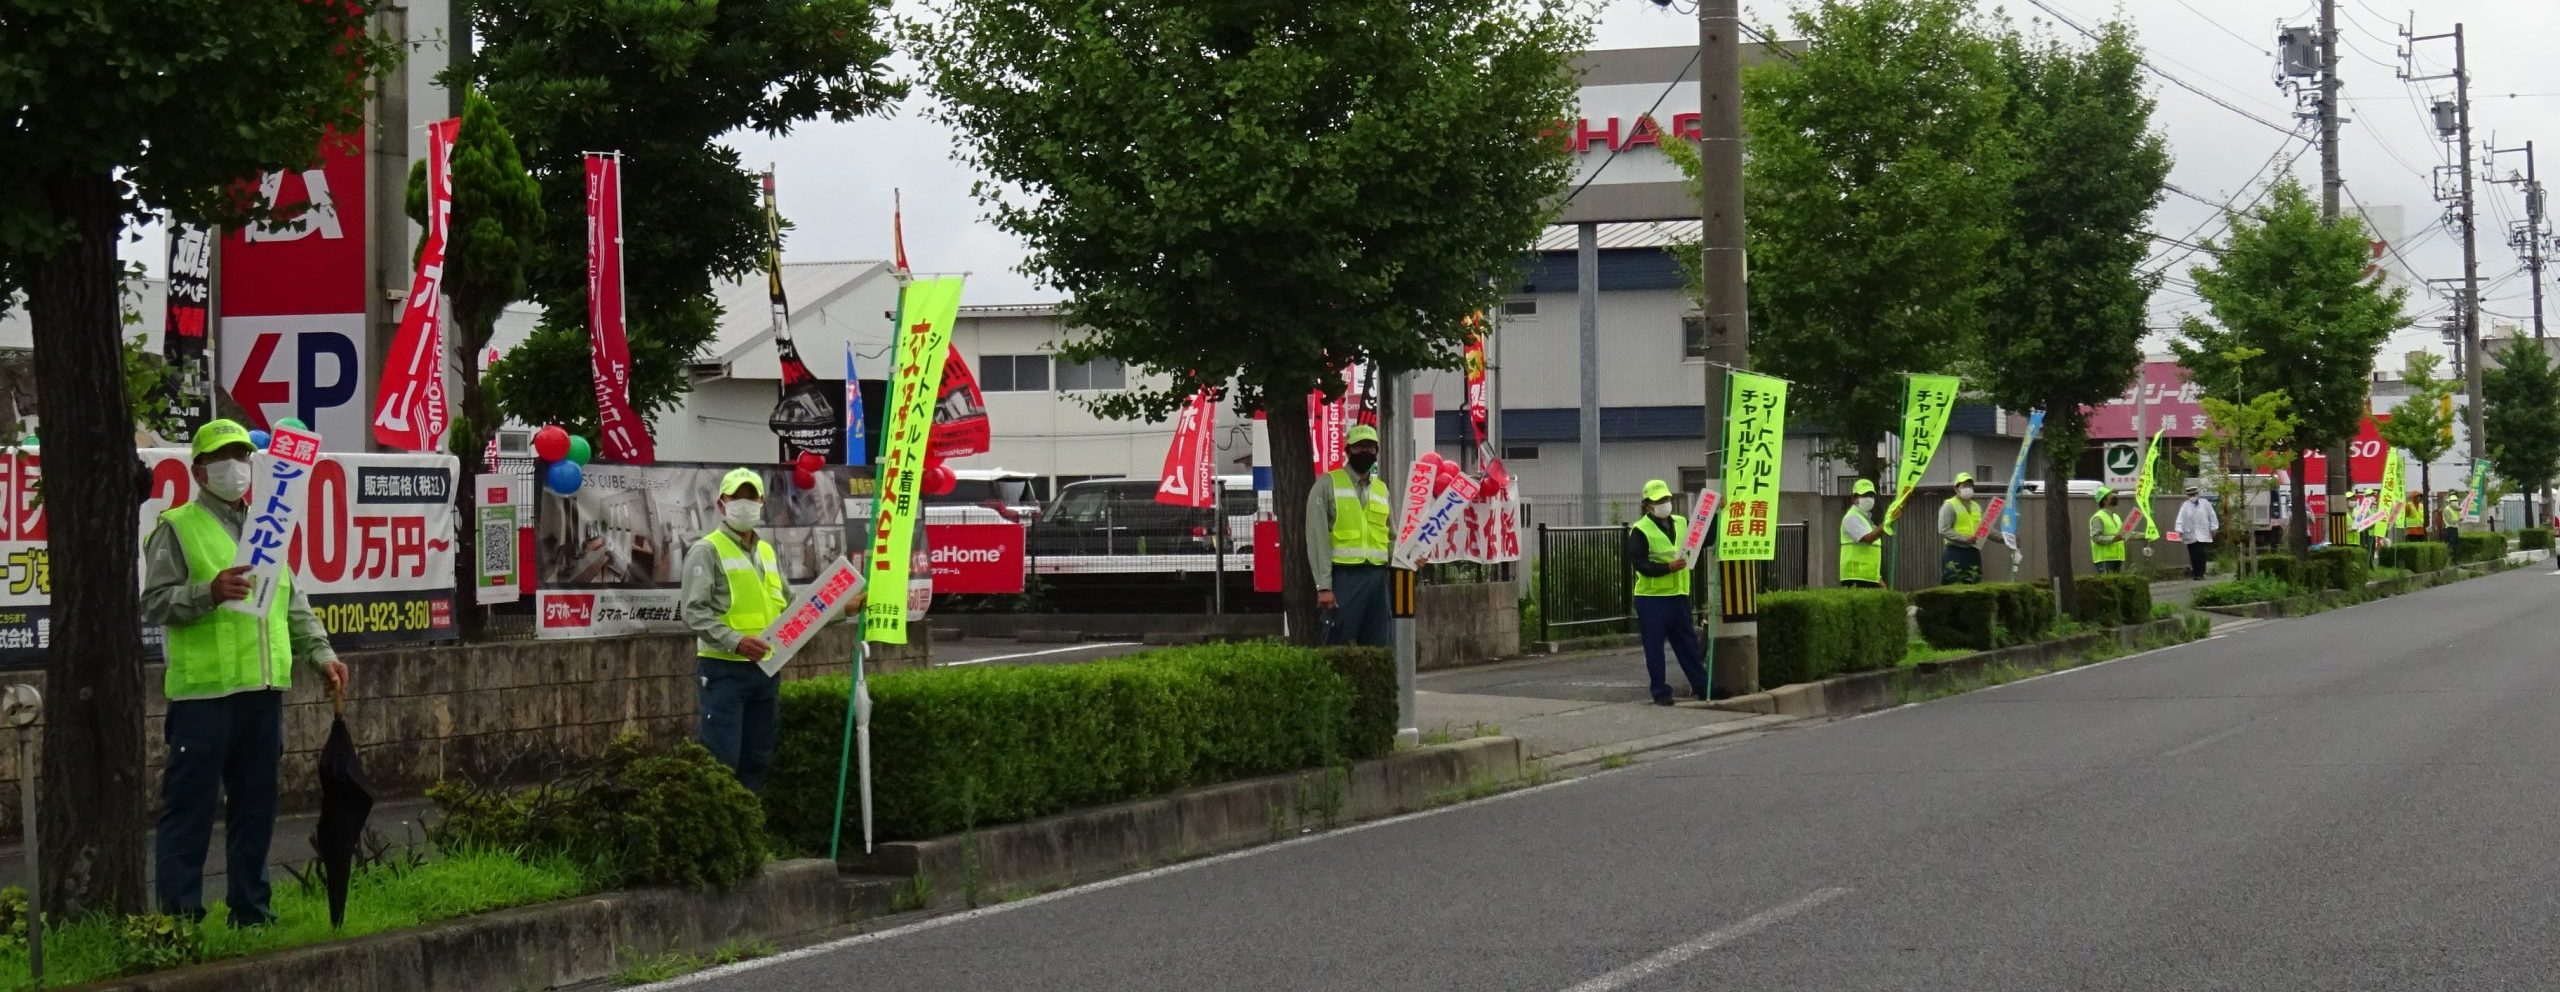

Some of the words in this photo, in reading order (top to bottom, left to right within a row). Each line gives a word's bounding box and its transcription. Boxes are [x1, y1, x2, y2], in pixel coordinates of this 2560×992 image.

[894, 332, 942, 517] シートベルト着用
[272, 434, 316, 462] 全席
[599, 476, 626, 489] CUBE
[249, 461, 304, 566] シートベルト
[1418, 491, 1464, 545] シートベルト
[328, 601, 429, 634] 0120-923-360
[547, 603, 590, 620] タマホーム
[598, 606, 672, 622] タマホーム株式会社
